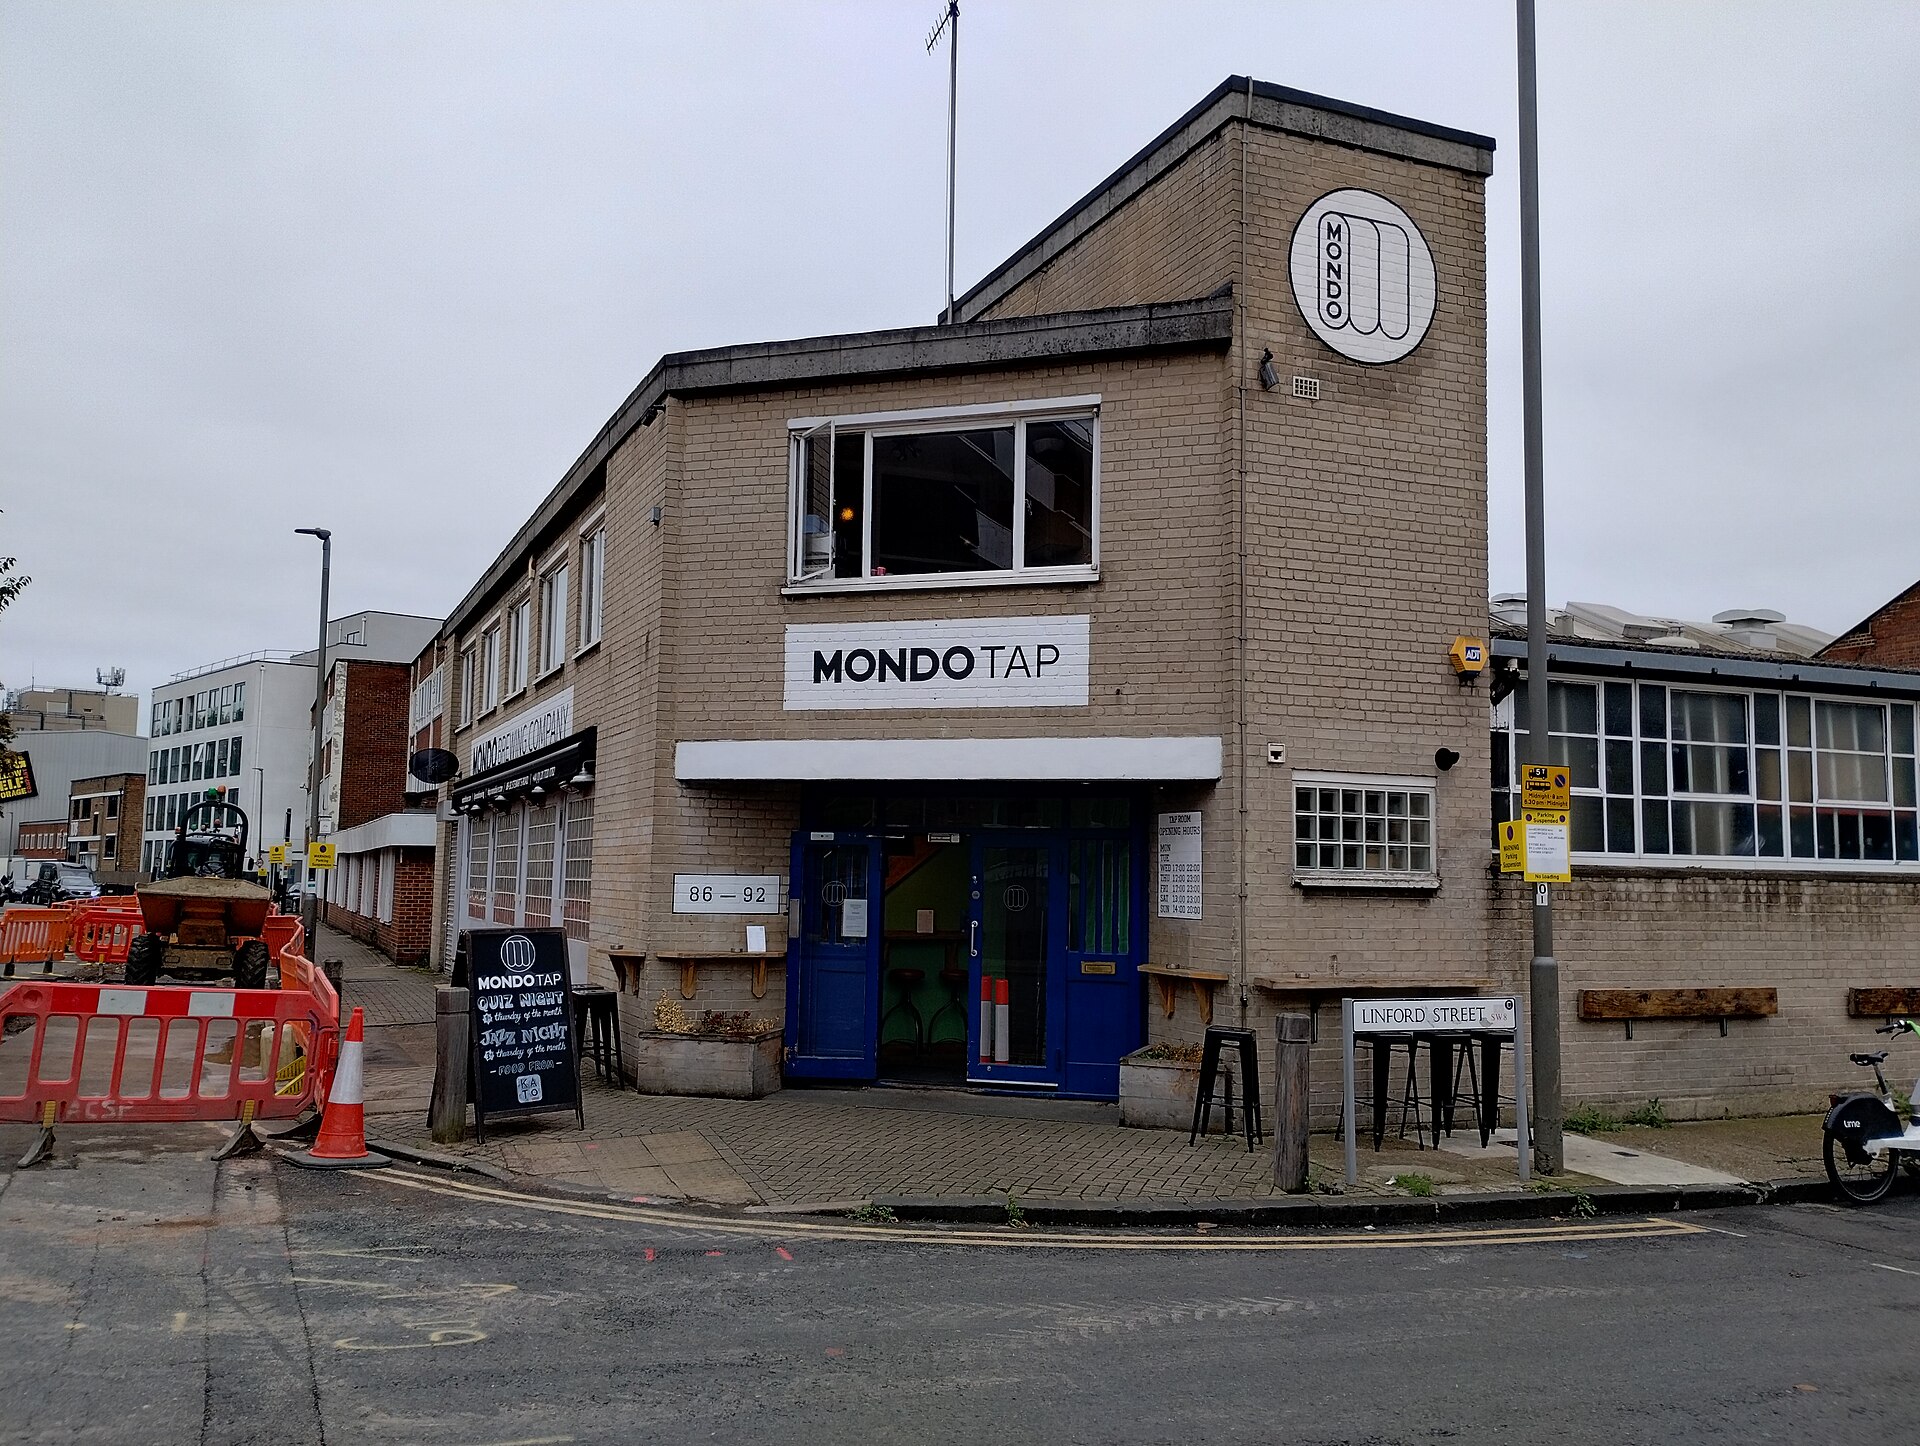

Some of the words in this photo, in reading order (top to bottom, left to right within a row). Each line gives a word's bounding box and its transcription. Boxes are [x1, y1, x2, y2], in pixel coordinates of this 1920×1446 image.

[1326, 222, 1342, 319] MONDO
[1466, 649, 1480, 660] ADT
[529, 704, 569, 752] COMPANY
[1160, 843, 1171, 852] MON
[1503, 844, 1520, 852] WARNING
[1160, 854, 1170, 862] TUE
[689, 886, 713, 902] 86
[743, 886, 766, 902] 92
[477, 993, 514, 1012] QUIZ
[518, 991, 564, 1008] NIGHT
[523, 1011, 531, 1022] of
[531, 1008, 541, 1018] the
[543, 1006, 563, 1017] month
[1362, 1008, 1426, 1024] LINFORD
[1433, 1006, 1486, 1023] STREET
[1490, 1013, 1508, 1021] SW8
[480, 1028, 516, 1047] JAZZ
[521, 1022, 568, 1043] NIGHT
[526, 1047, 534, 1059] of
[535, 1044, 545, 1053] the
[546, 1041, 567, 1052] month
[498, 1062, 526, 1076] FOOD
[528, 1060, 554, 1072] FROM
